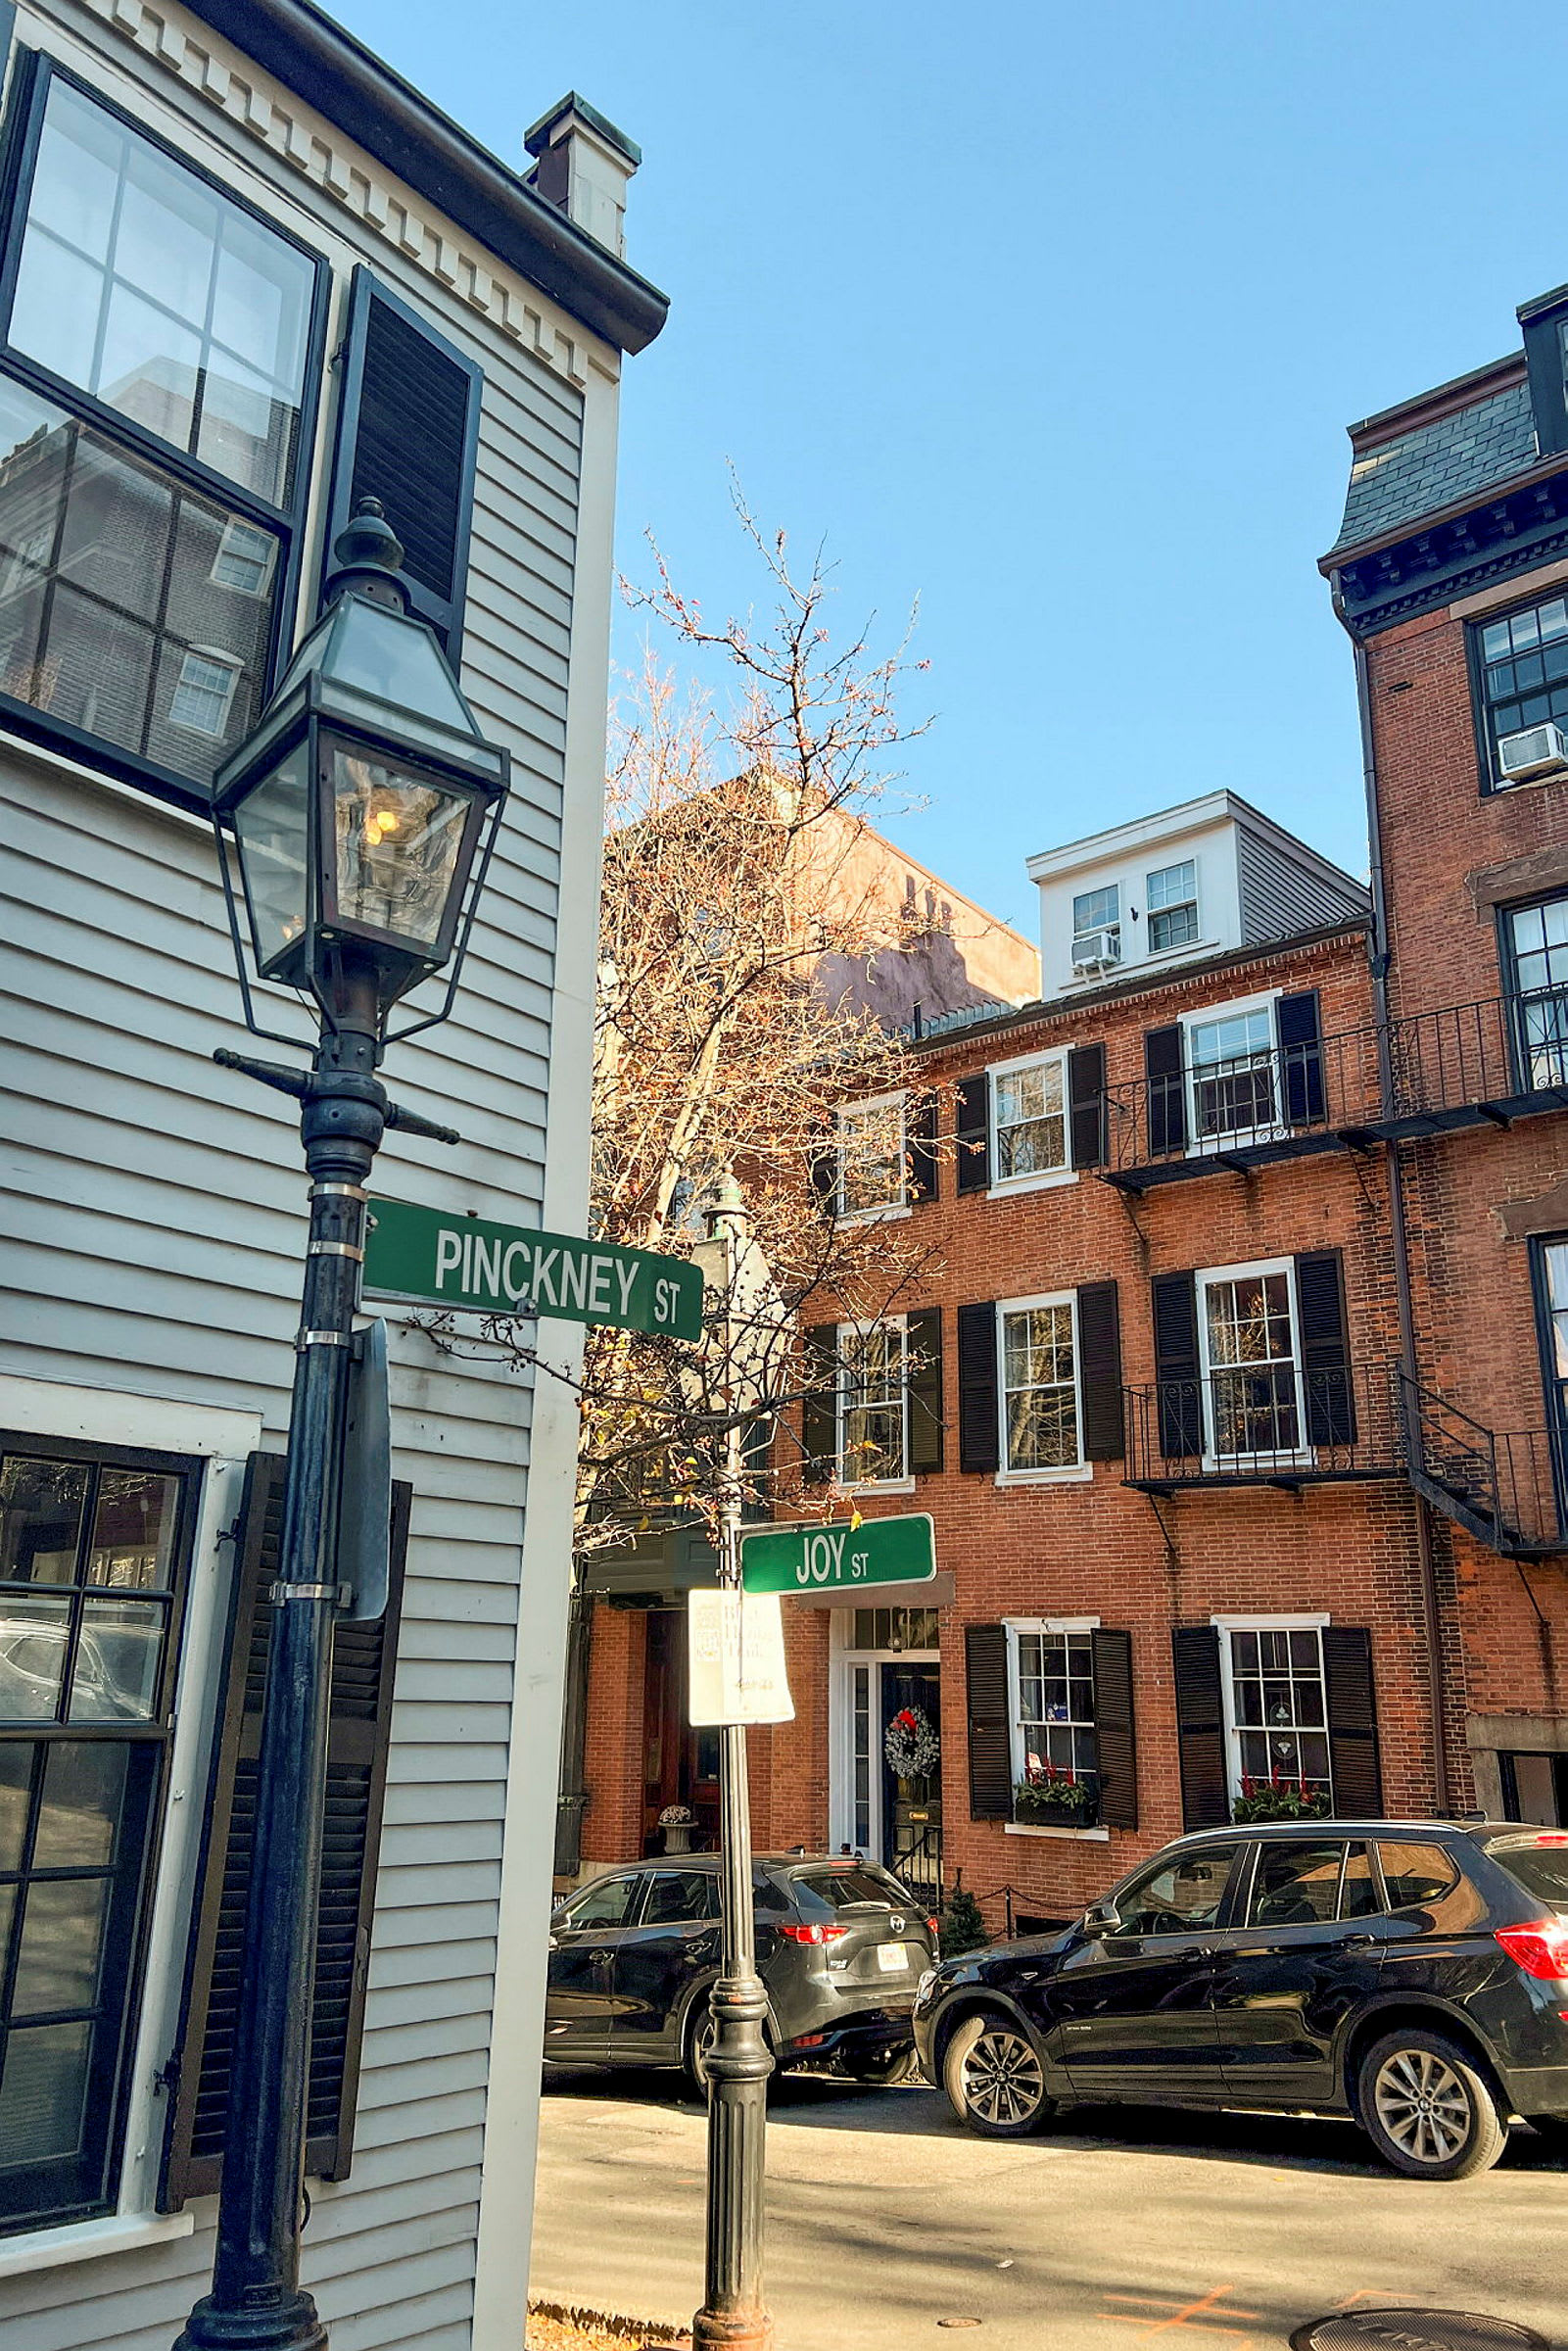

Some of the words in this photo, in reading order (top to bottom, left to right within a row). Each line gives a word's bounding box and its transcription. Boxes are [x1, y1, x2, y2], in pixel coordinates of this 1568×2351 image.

[435, 1229, 640, 1316] PINCKNEY
[653, 1278, 681, 1324] ST
[795, 1533, 846, 1584] JOY
[851, 1553, 869, 1579] ST
